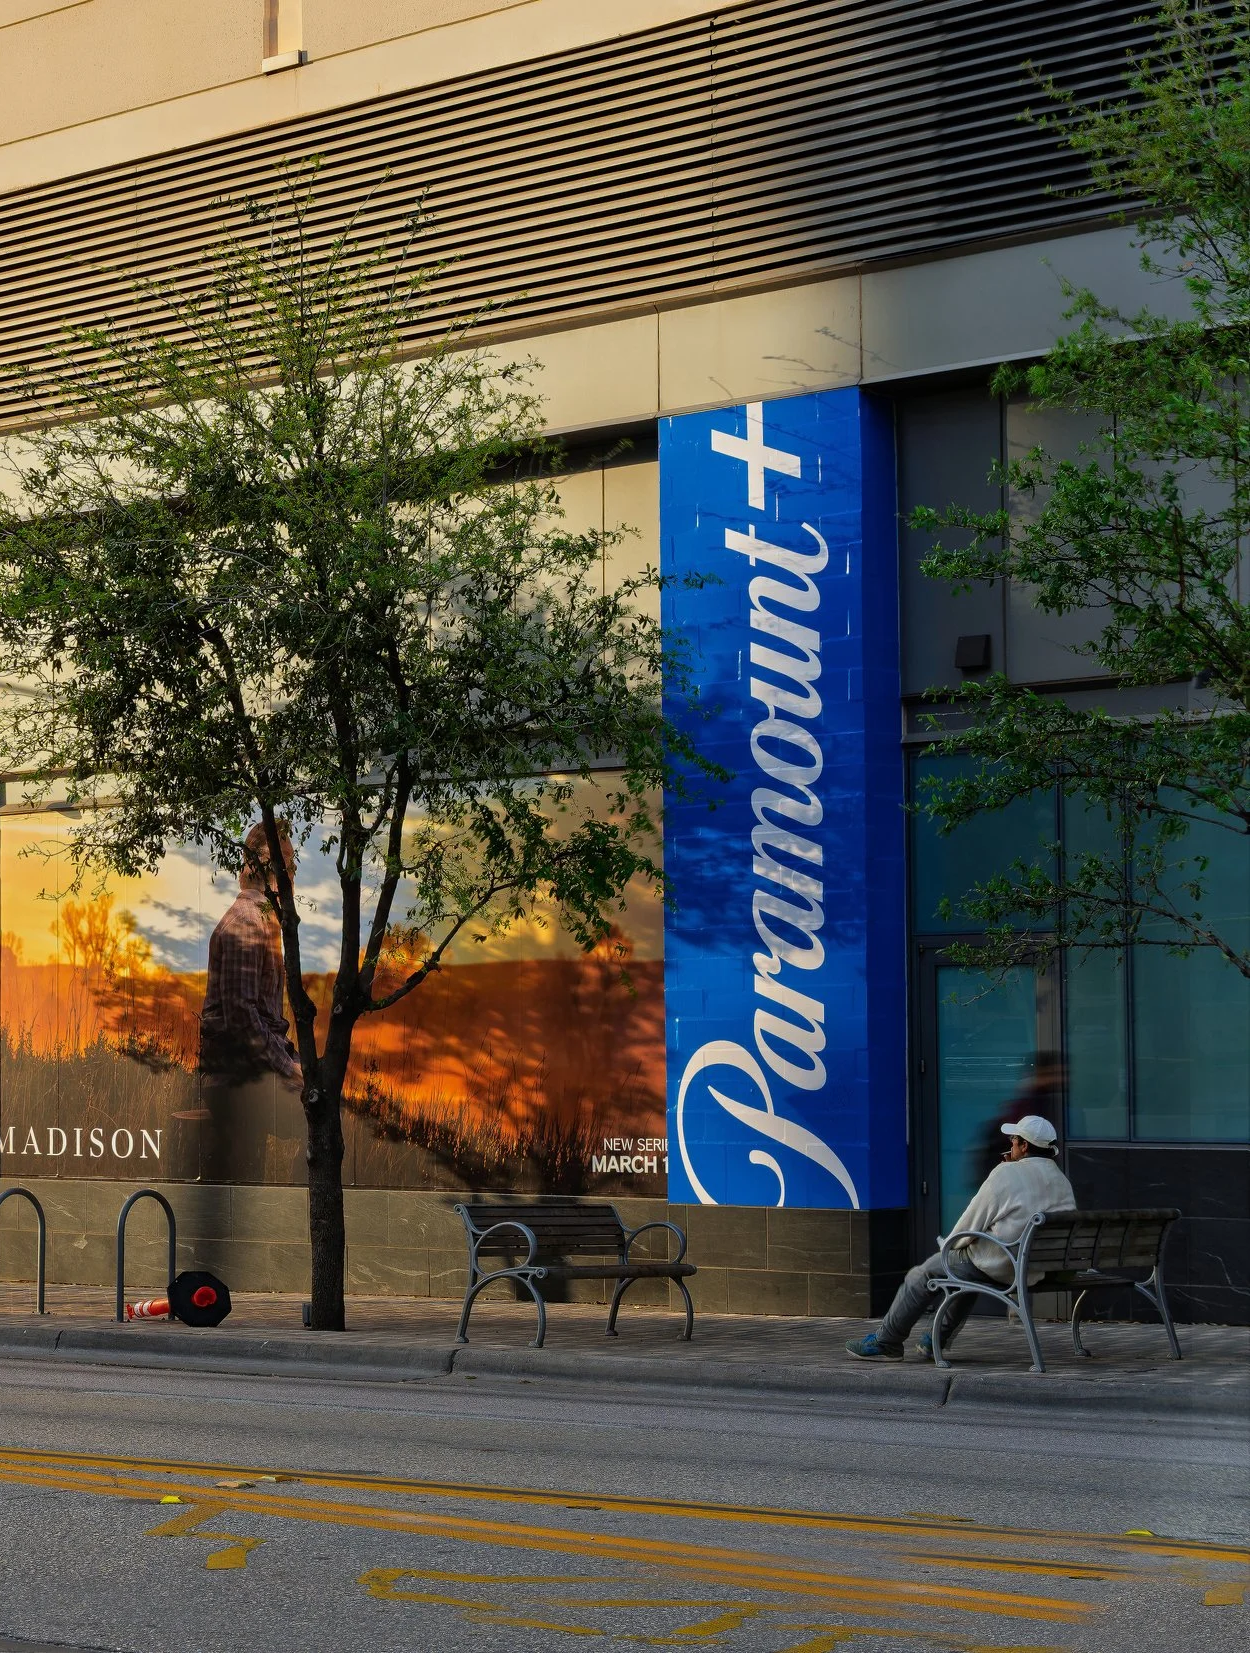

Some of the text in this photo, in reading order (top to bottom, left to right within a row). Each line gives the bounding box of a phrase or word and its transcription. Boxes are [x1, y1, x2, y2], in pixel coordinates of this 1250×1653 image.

[676, 400, 861, 1211] Paramount+
[603, 1137, 634, 1152] NEW
[591, 1154, 658, 1174] MARCH
